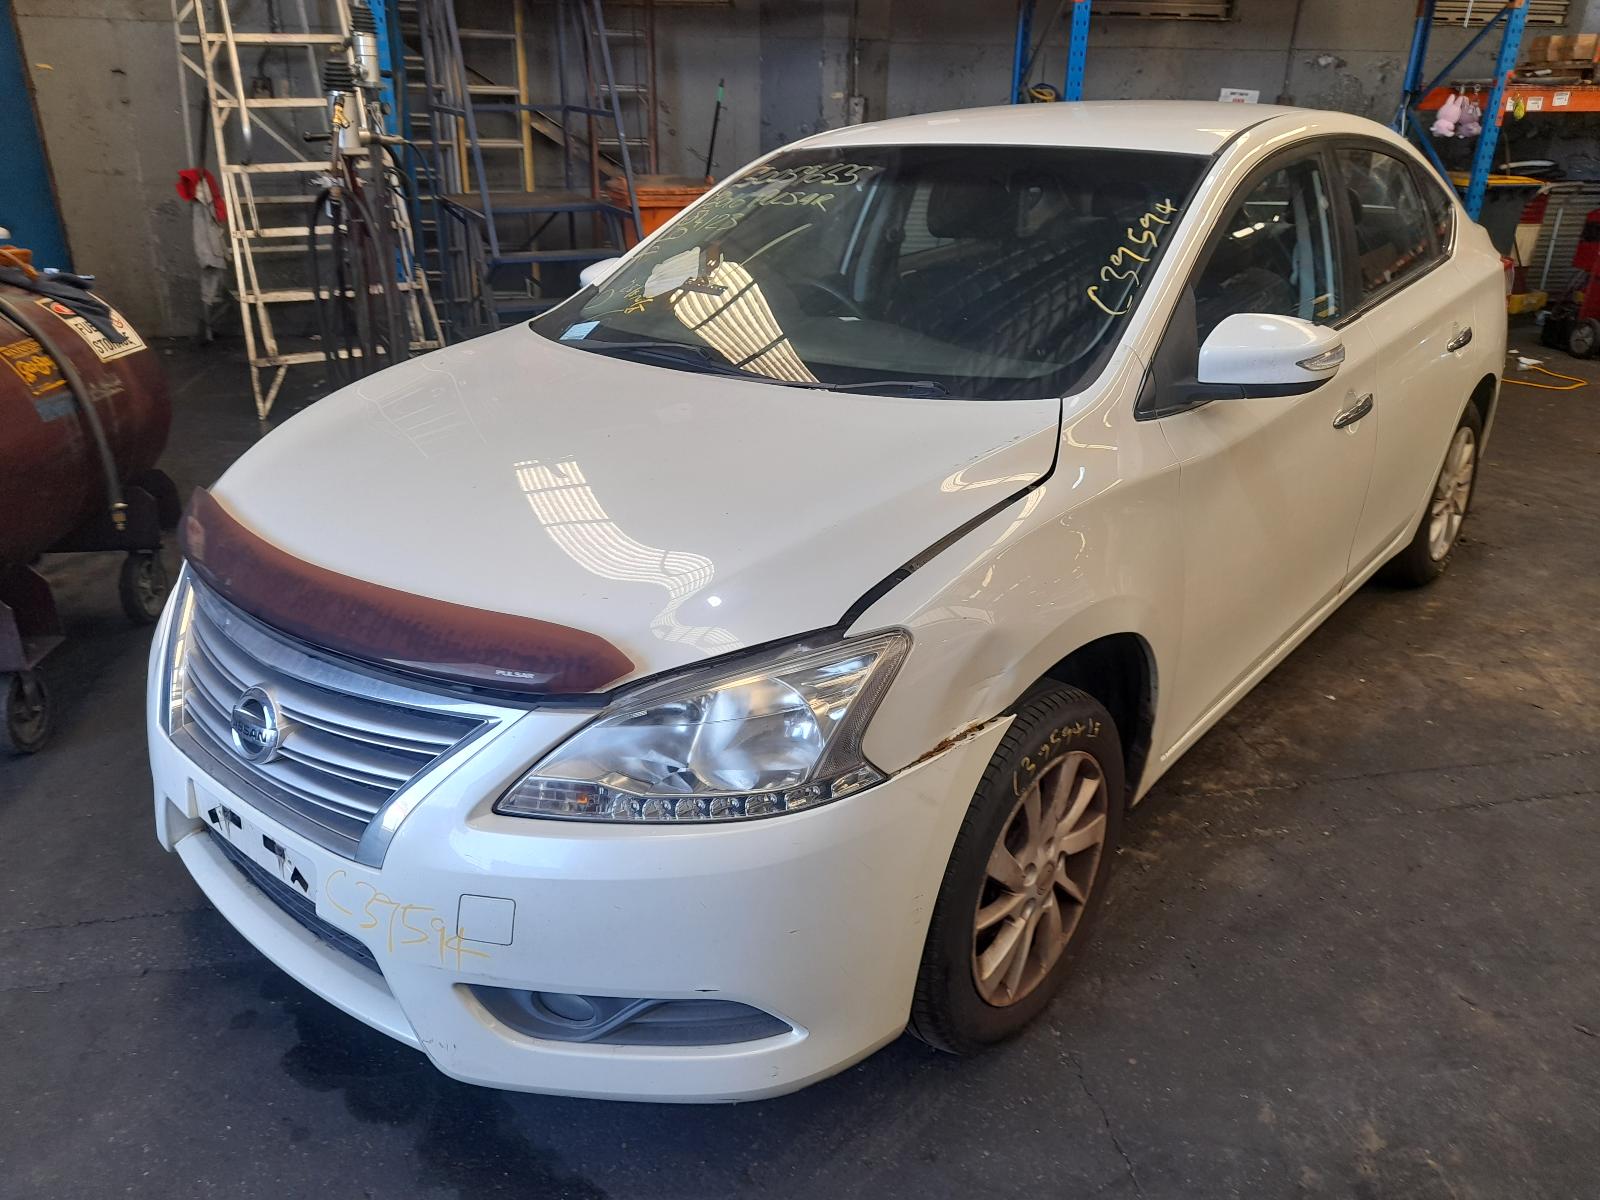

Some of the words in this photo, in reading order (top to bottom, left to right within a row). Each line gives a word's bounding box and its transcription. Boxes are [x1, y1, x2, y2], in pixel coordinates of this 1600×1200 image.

[1087, 198, 1178, 316] C39594
[495, 669, 535, 679] PULSAR
[232, 716, 268, 743] NISSAN
